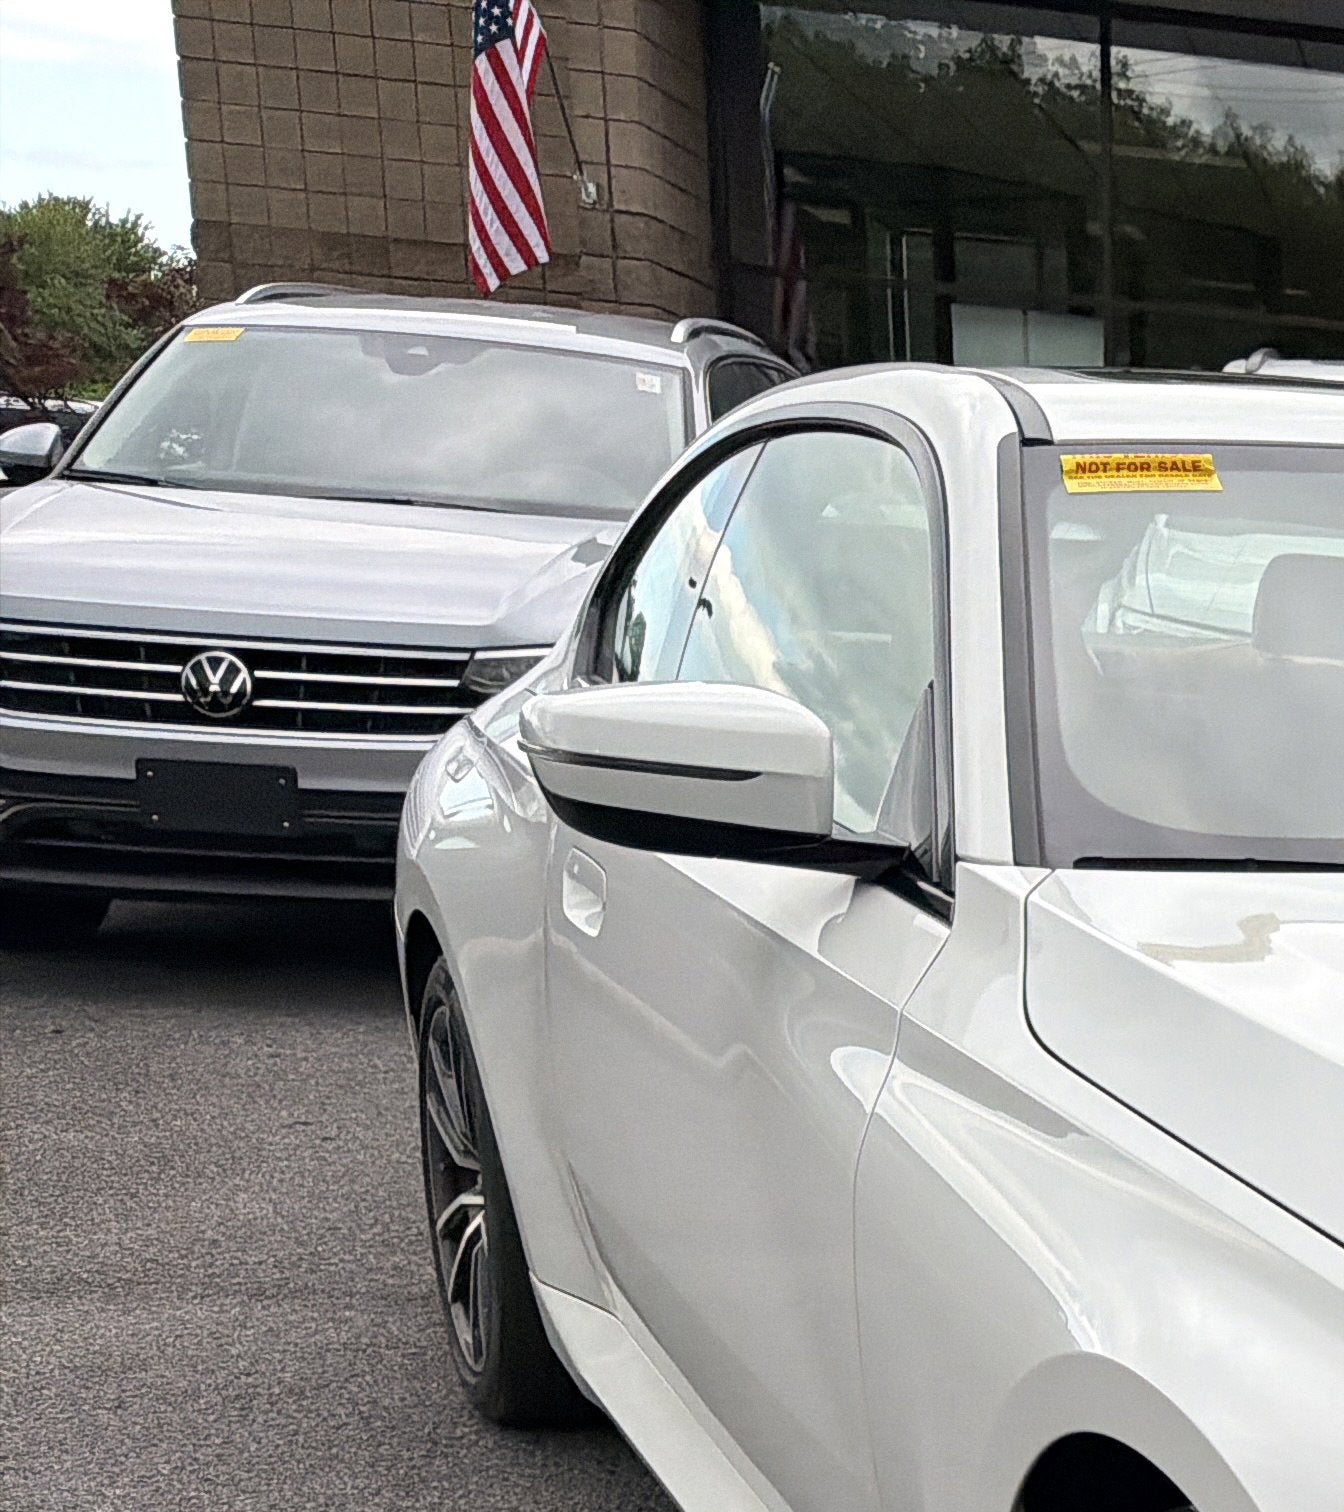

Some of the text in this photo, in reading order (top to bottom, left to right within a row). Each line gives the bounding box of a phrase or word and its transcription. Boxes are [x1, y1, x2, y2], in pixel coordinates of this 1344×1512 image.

[1075, 460, 1203, 474] NOT FOR SALE
